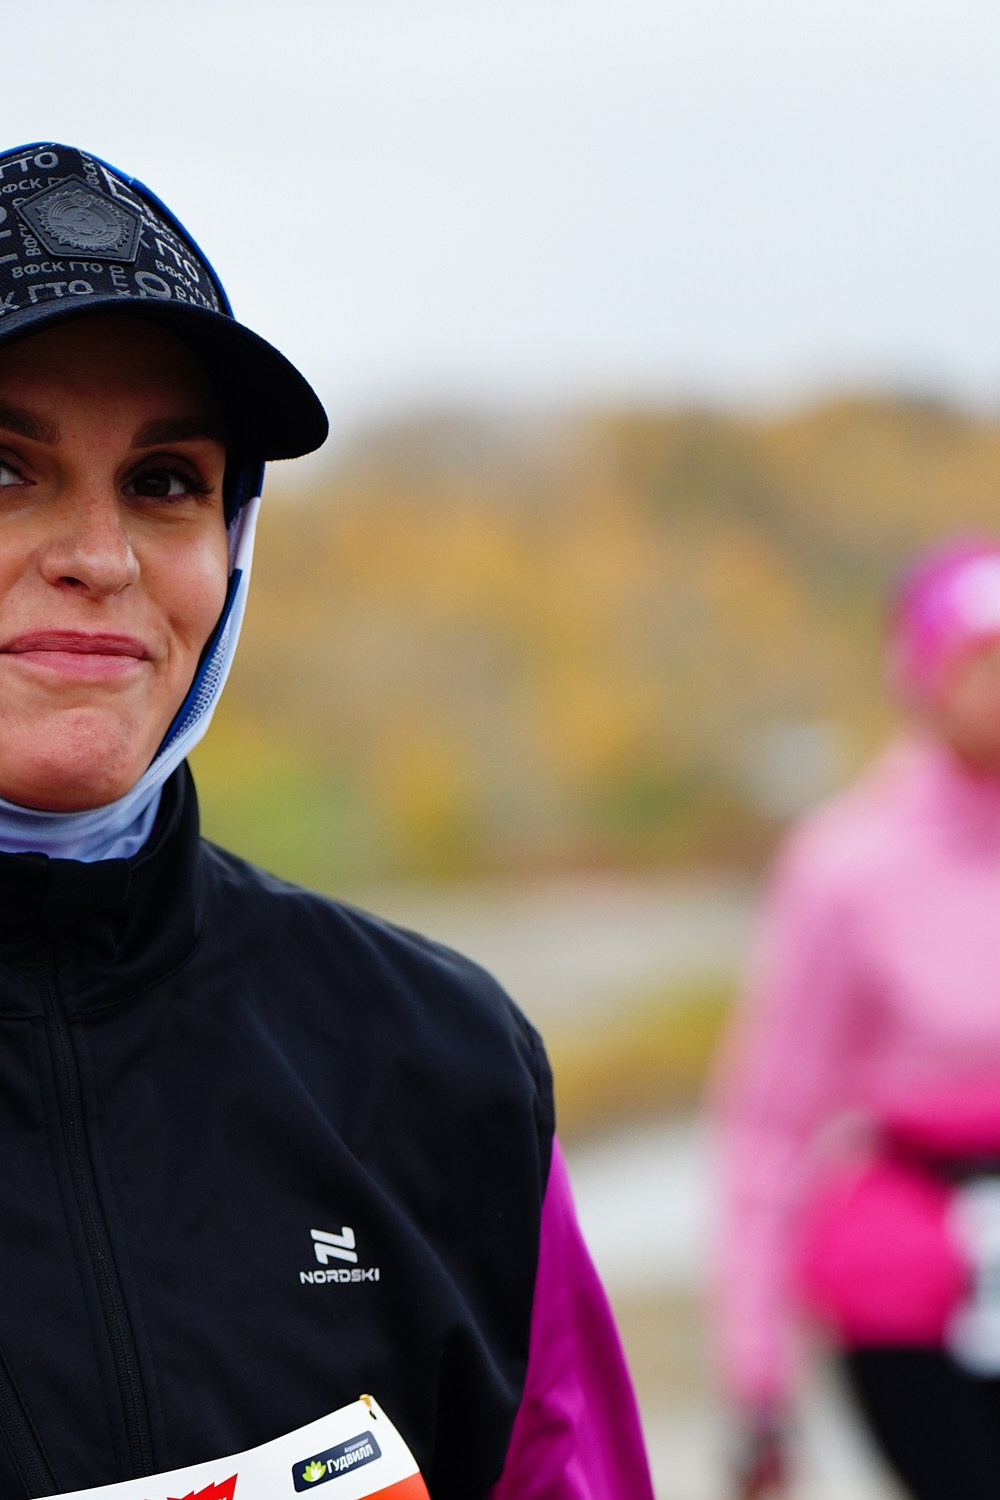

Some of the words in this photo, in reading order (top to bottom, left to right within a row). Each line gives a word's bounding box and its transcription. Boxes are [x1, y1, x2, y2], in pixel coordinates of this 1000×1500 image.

[12, 260, 66, 280] ВФСК
[69, 262, 103, 273] ГТО
[155, 237, 200, 283] ГТО
[26, 279, 95, 304] ГТО
[299, 1267, 380, 1284] NORDSKI
